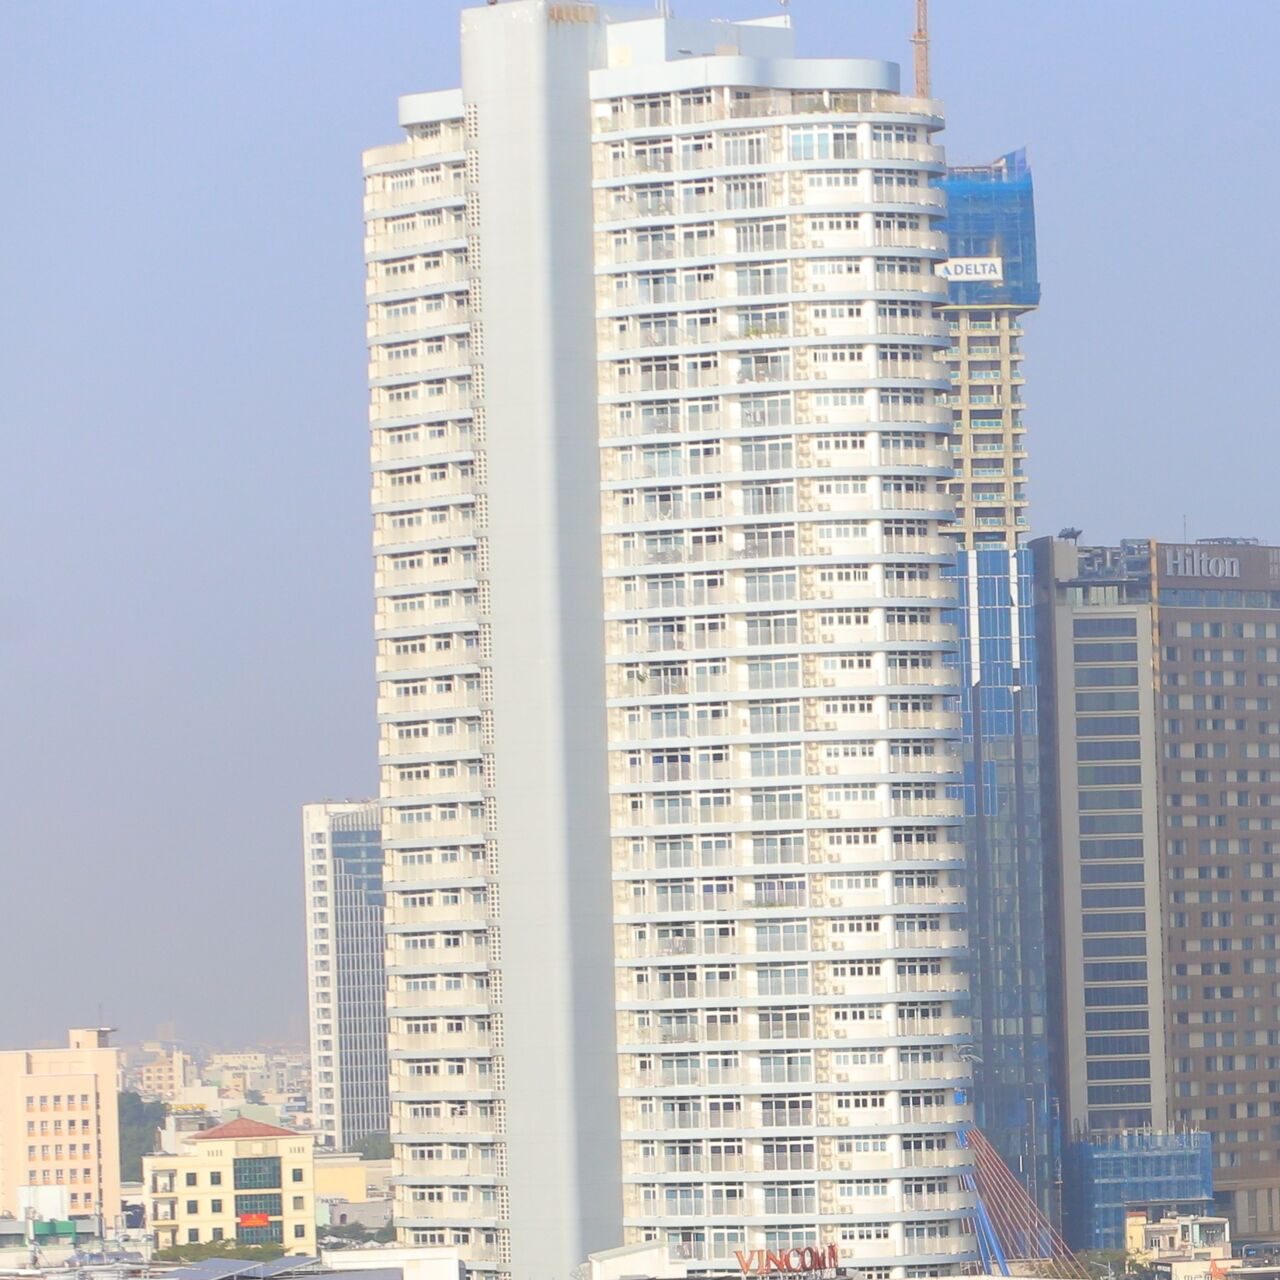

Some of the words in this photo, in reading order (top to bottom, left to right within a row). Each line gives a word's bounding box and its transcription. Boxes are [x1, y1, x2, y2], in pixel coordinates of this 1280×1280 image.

[954, 264, 998, 275] DELTA
[1165, 547, 1240, 577] Hilton
[735, 1246, 828, 1275] VINCOM
